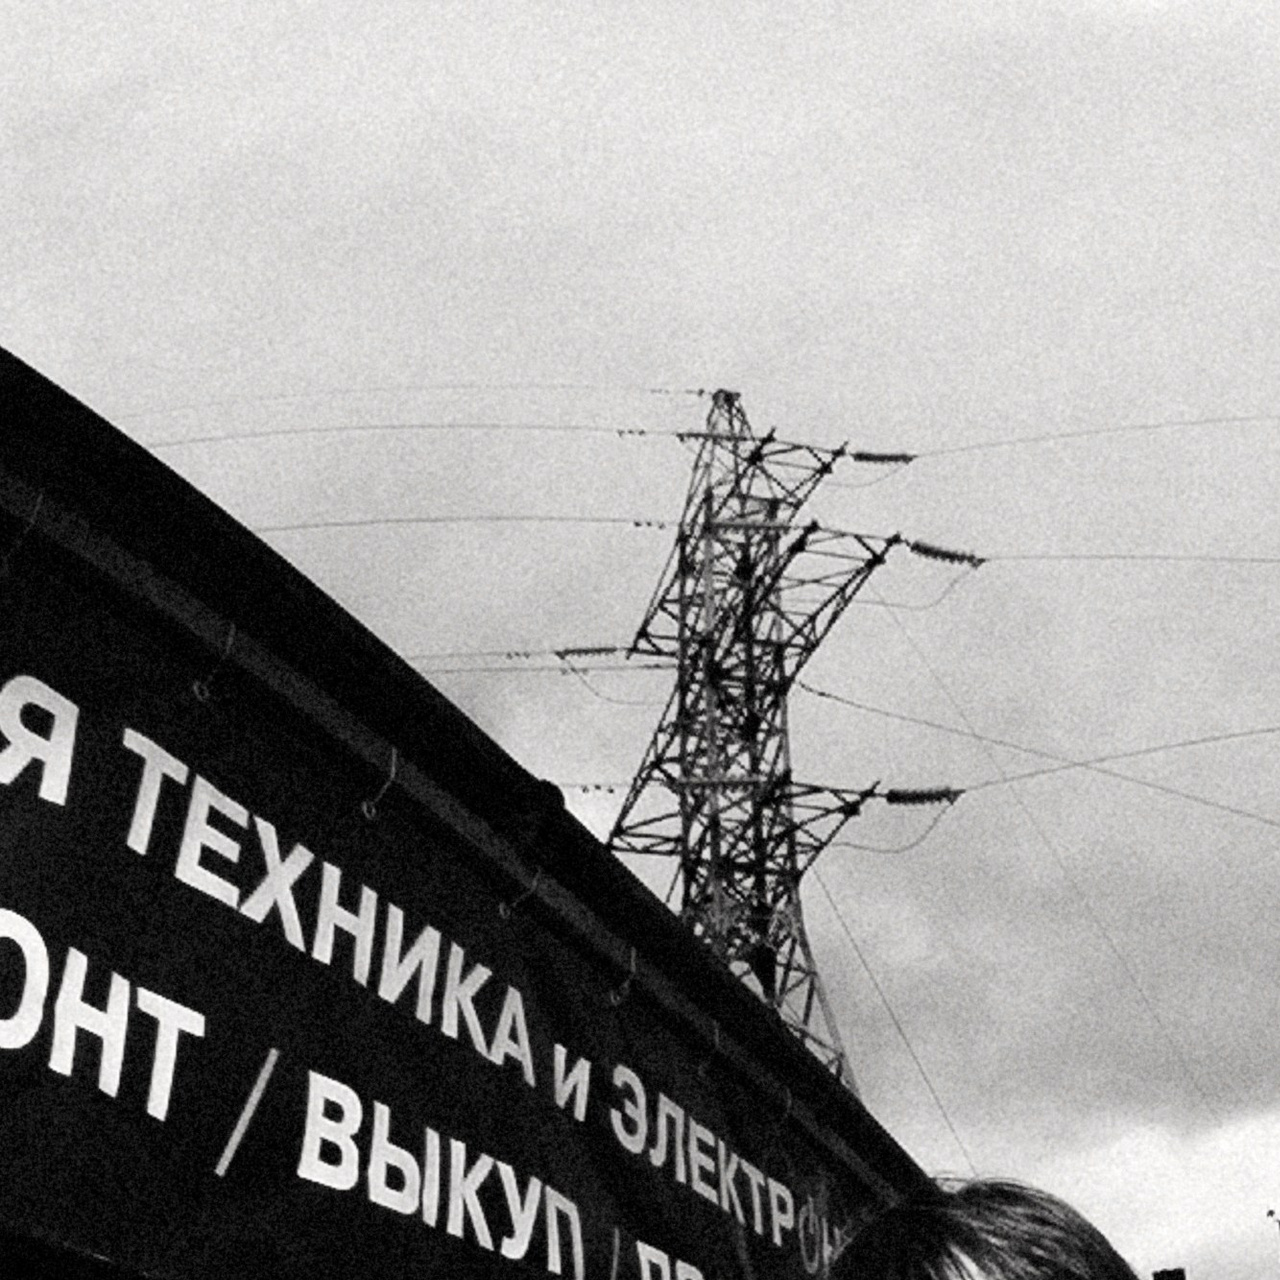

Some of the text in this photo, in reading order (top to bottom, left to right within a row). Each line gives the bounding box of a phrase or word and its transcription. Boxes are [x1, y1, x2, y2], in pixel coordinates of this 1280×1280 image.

[0, 675, 79, 806] Я
[122, 727, 536, 1088] ТЕХНИКА
[553, 1043, 591, 1122] и
